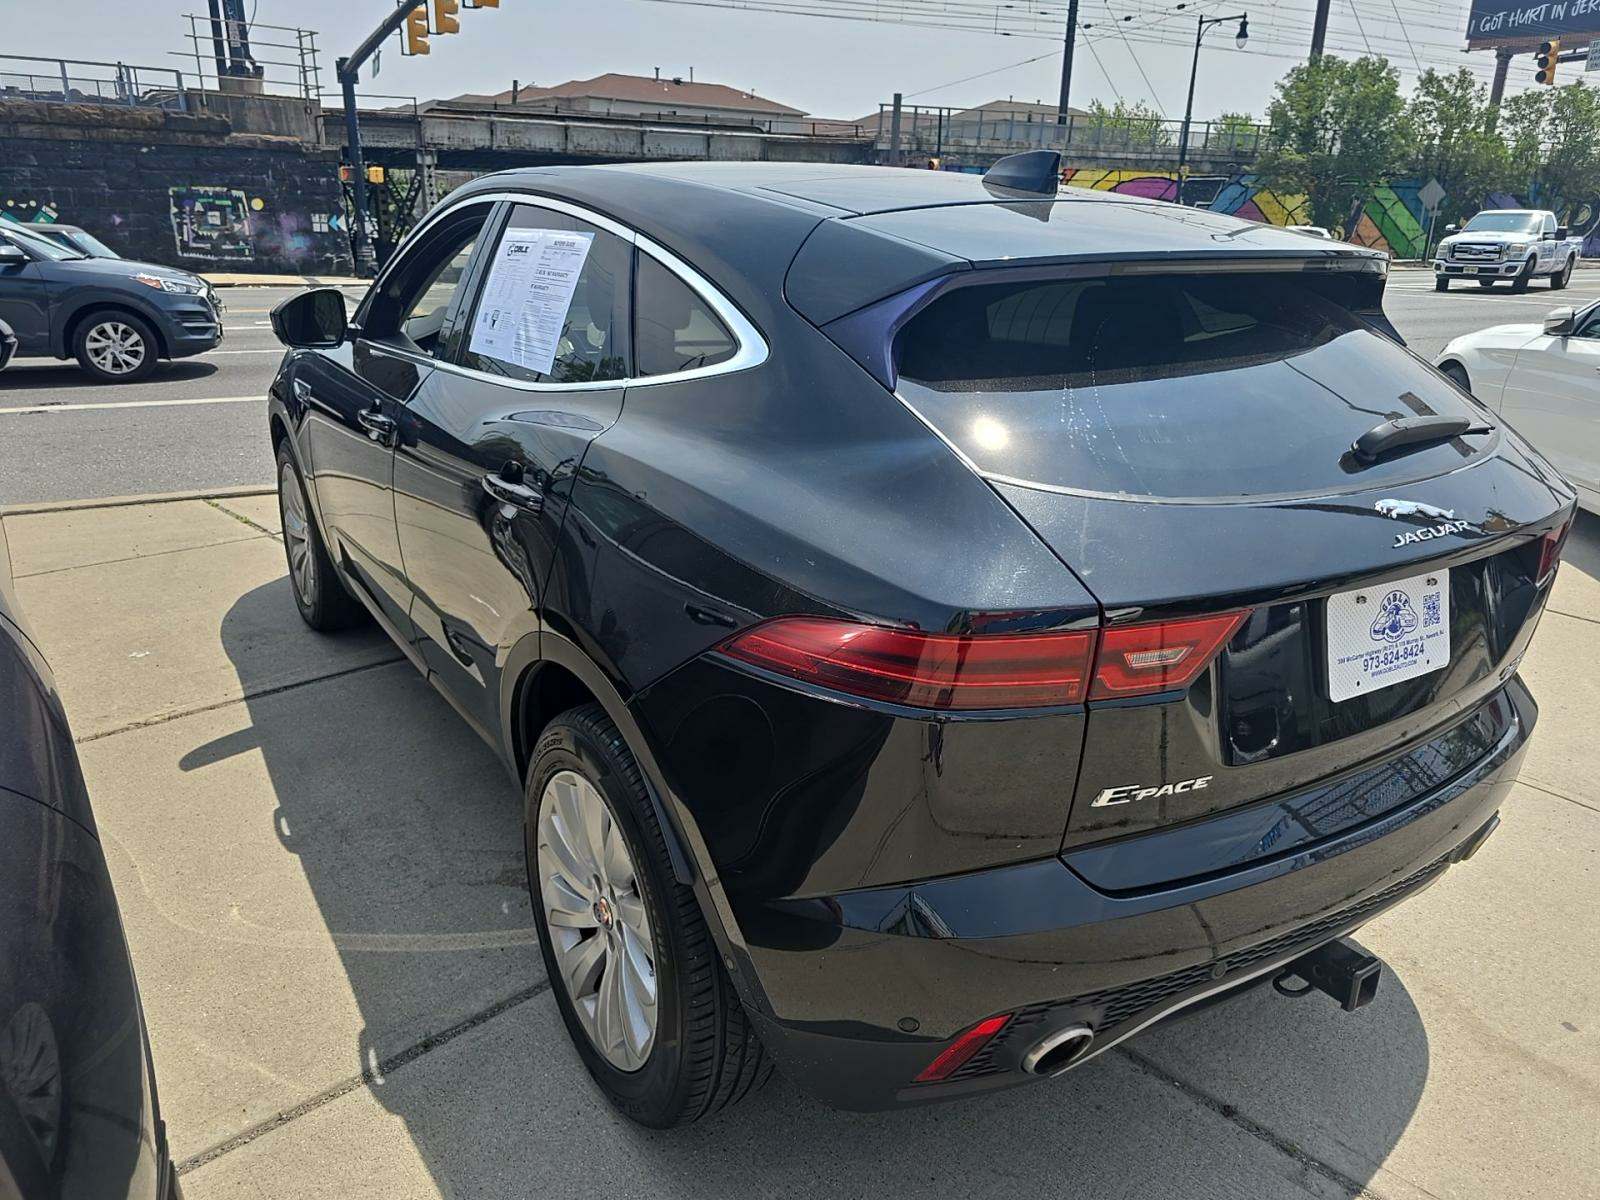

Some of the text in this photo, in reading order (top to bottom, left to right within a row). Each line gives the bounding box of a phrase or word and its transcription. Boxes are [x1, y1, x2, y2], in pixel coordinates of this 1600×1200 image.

[1468, 0, 1600, 35] I GOT HURT IN JER
[1393, 520, 1471, 548] JAGUAR
[1363, 642, 1425, 672] 973-824-8424
